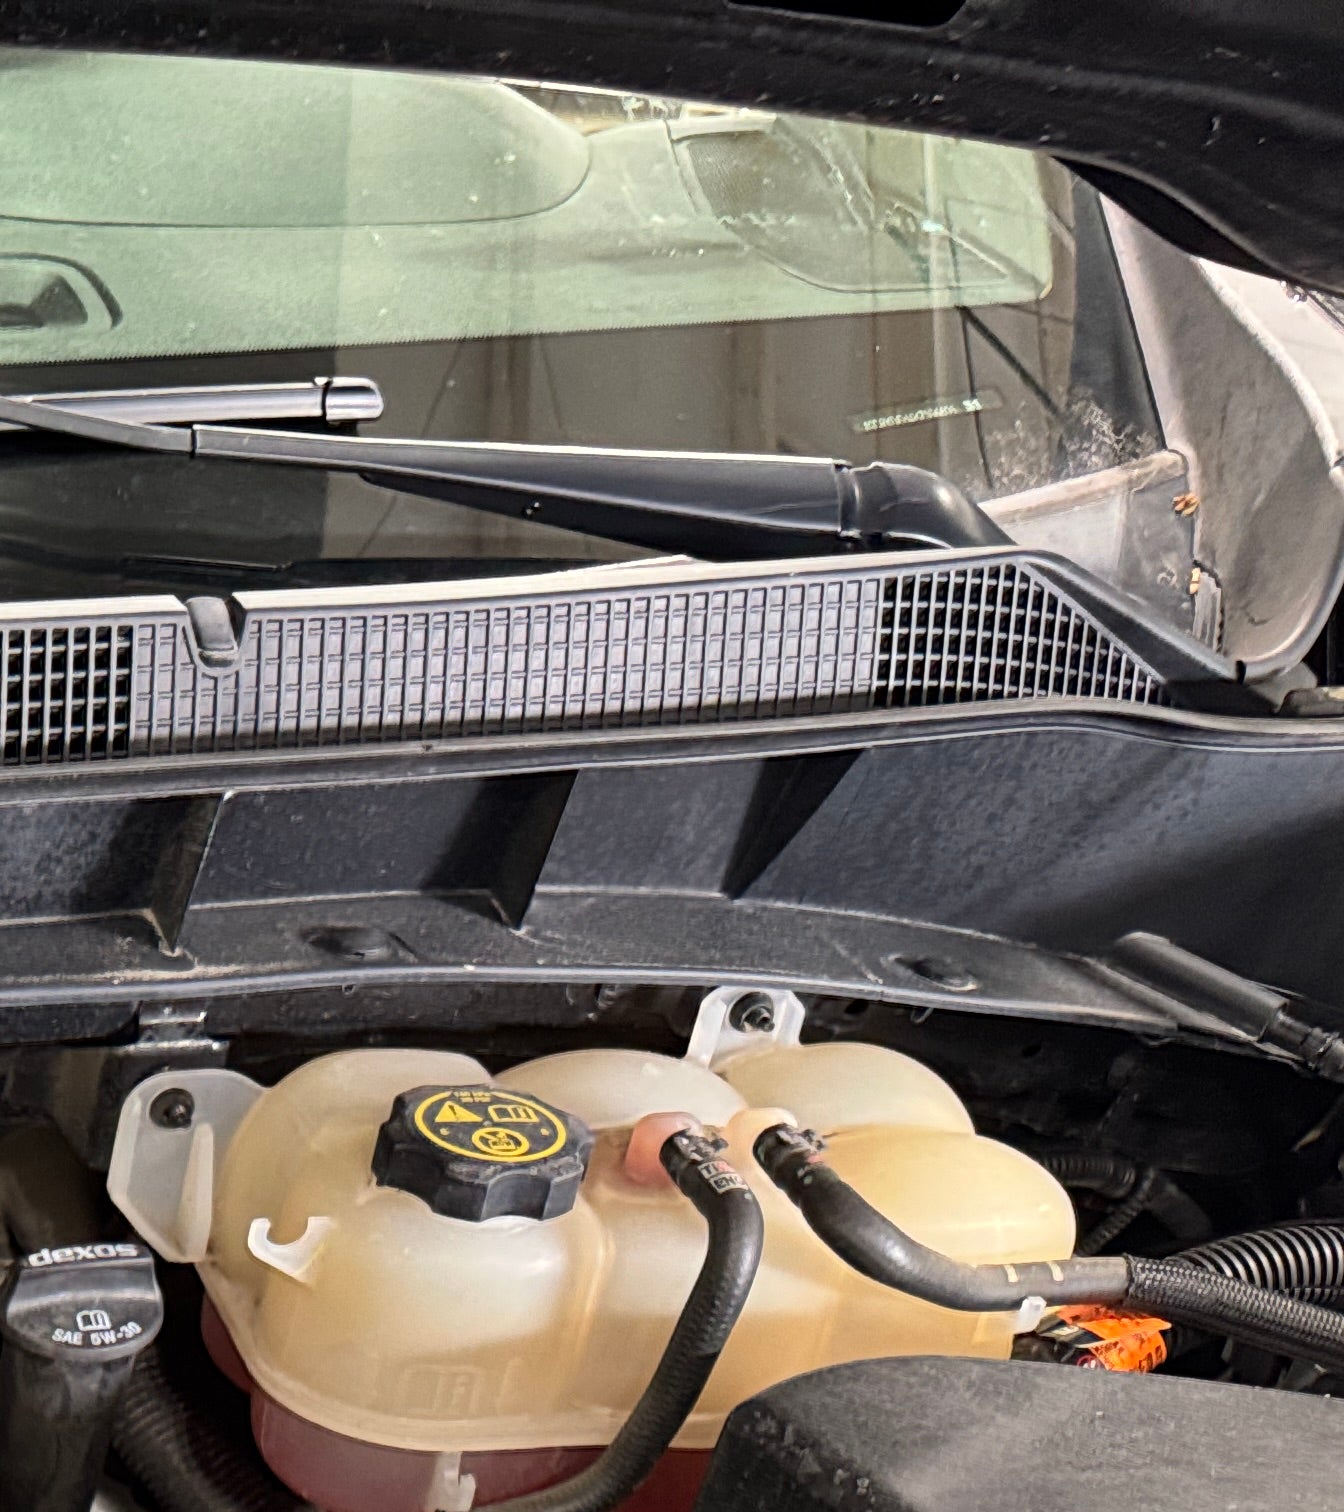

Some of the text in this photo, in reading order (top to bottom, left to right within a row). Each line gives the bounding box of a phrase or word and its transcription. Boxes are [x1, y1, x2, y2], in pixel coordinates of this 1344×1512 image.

[28, 1243, 139, 1267] dexos
[52, 1321, 143, 1346] SAE 5W-30
